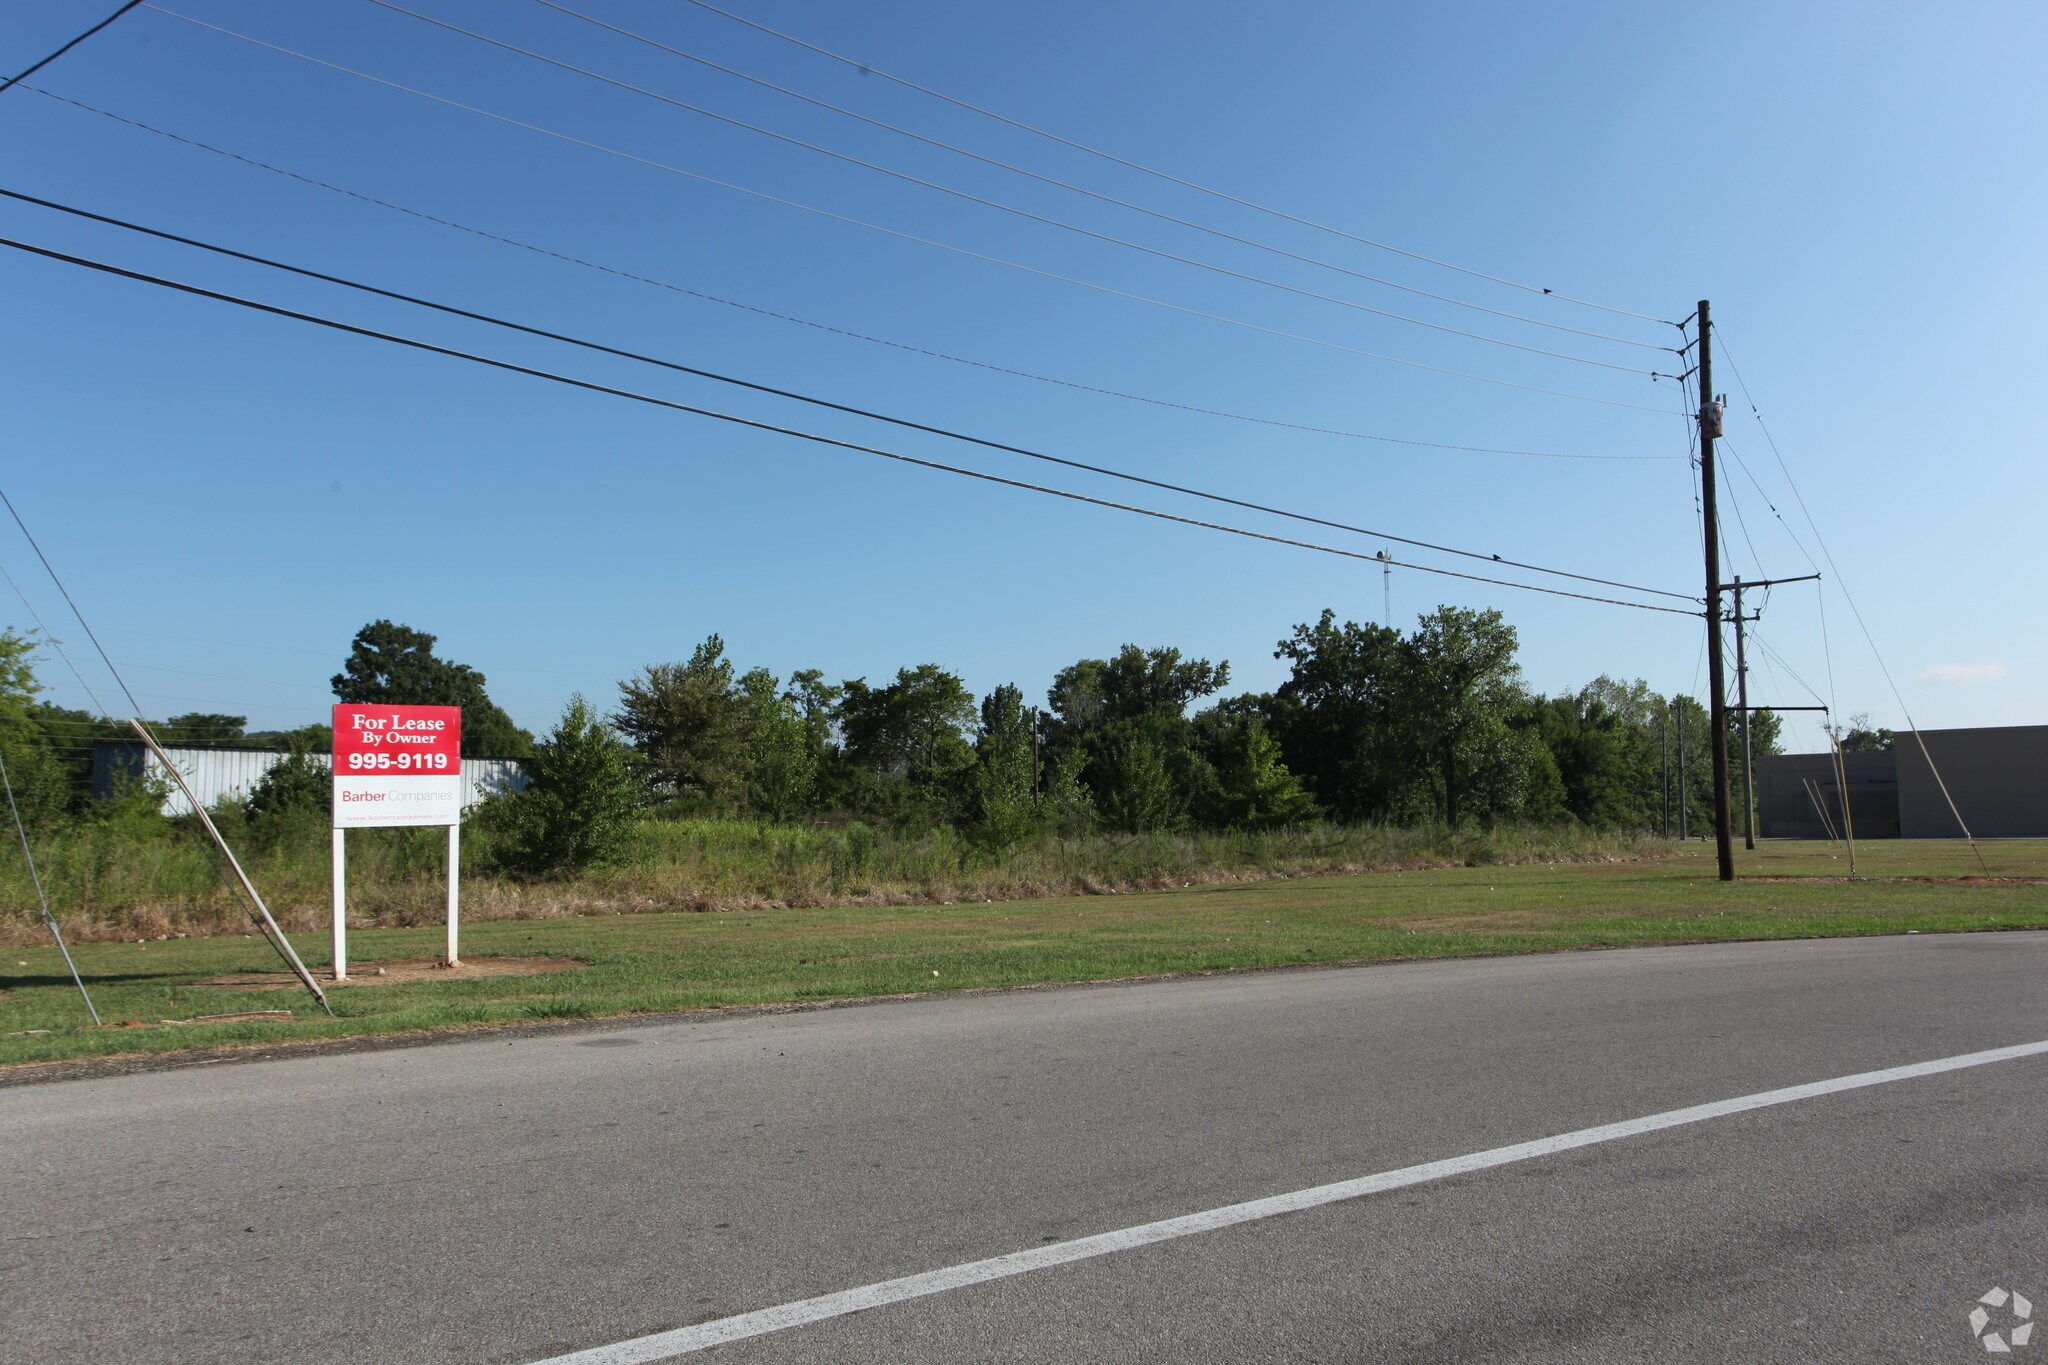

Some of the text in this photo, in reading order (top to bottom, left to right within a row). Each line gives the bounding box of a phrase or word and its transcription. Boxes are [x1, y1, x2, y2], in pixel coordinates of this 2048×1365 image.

[352, 714, 445, 730] For Lease
[362, 731, 437, 746] By Owner
[348, 753, 448, 769] 995-9119
[342, 790, 453, 803] Barber Companies
